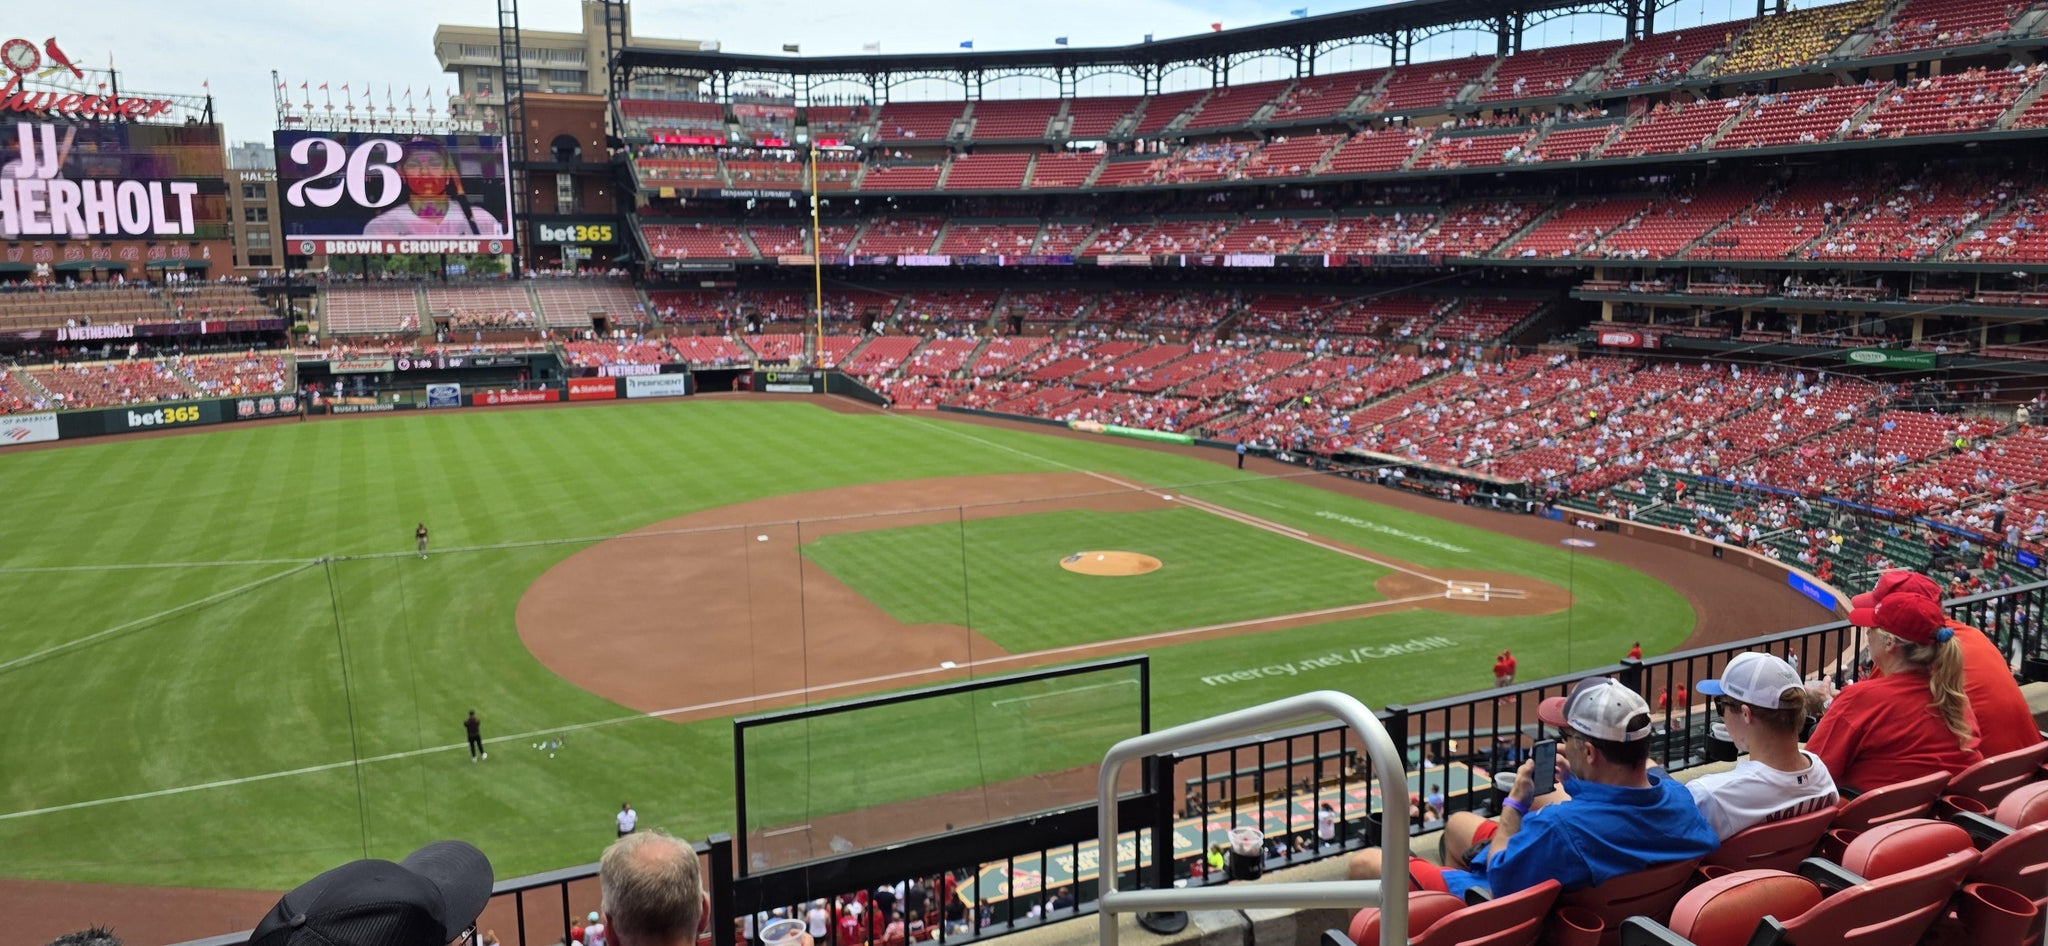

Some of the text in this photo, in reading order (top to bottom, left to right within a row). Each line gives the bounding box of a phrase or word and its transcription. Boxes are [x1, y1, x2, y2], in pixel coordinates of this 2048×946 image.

[302, 115, 484, 132] WORLD CHAMPIONS
[15, 122, 59, 179] JJ
[286, 137, 404, 208] 26
[540, 224, 612, 241] bet365
[120, 247, 139, 260] 42
[326, 241, 382, 253] BROWN
[386, 243, 395, 253] &
[400, 240, 479, 253] CROUPPEN
[57, 324, 134, 341] JJ WETHERHOLT
[597, 363, 660, 377] JJ WETHERHOLT
[15, 415, 54, 423] AMERICA
[128, 405, 200, 428] bet365
